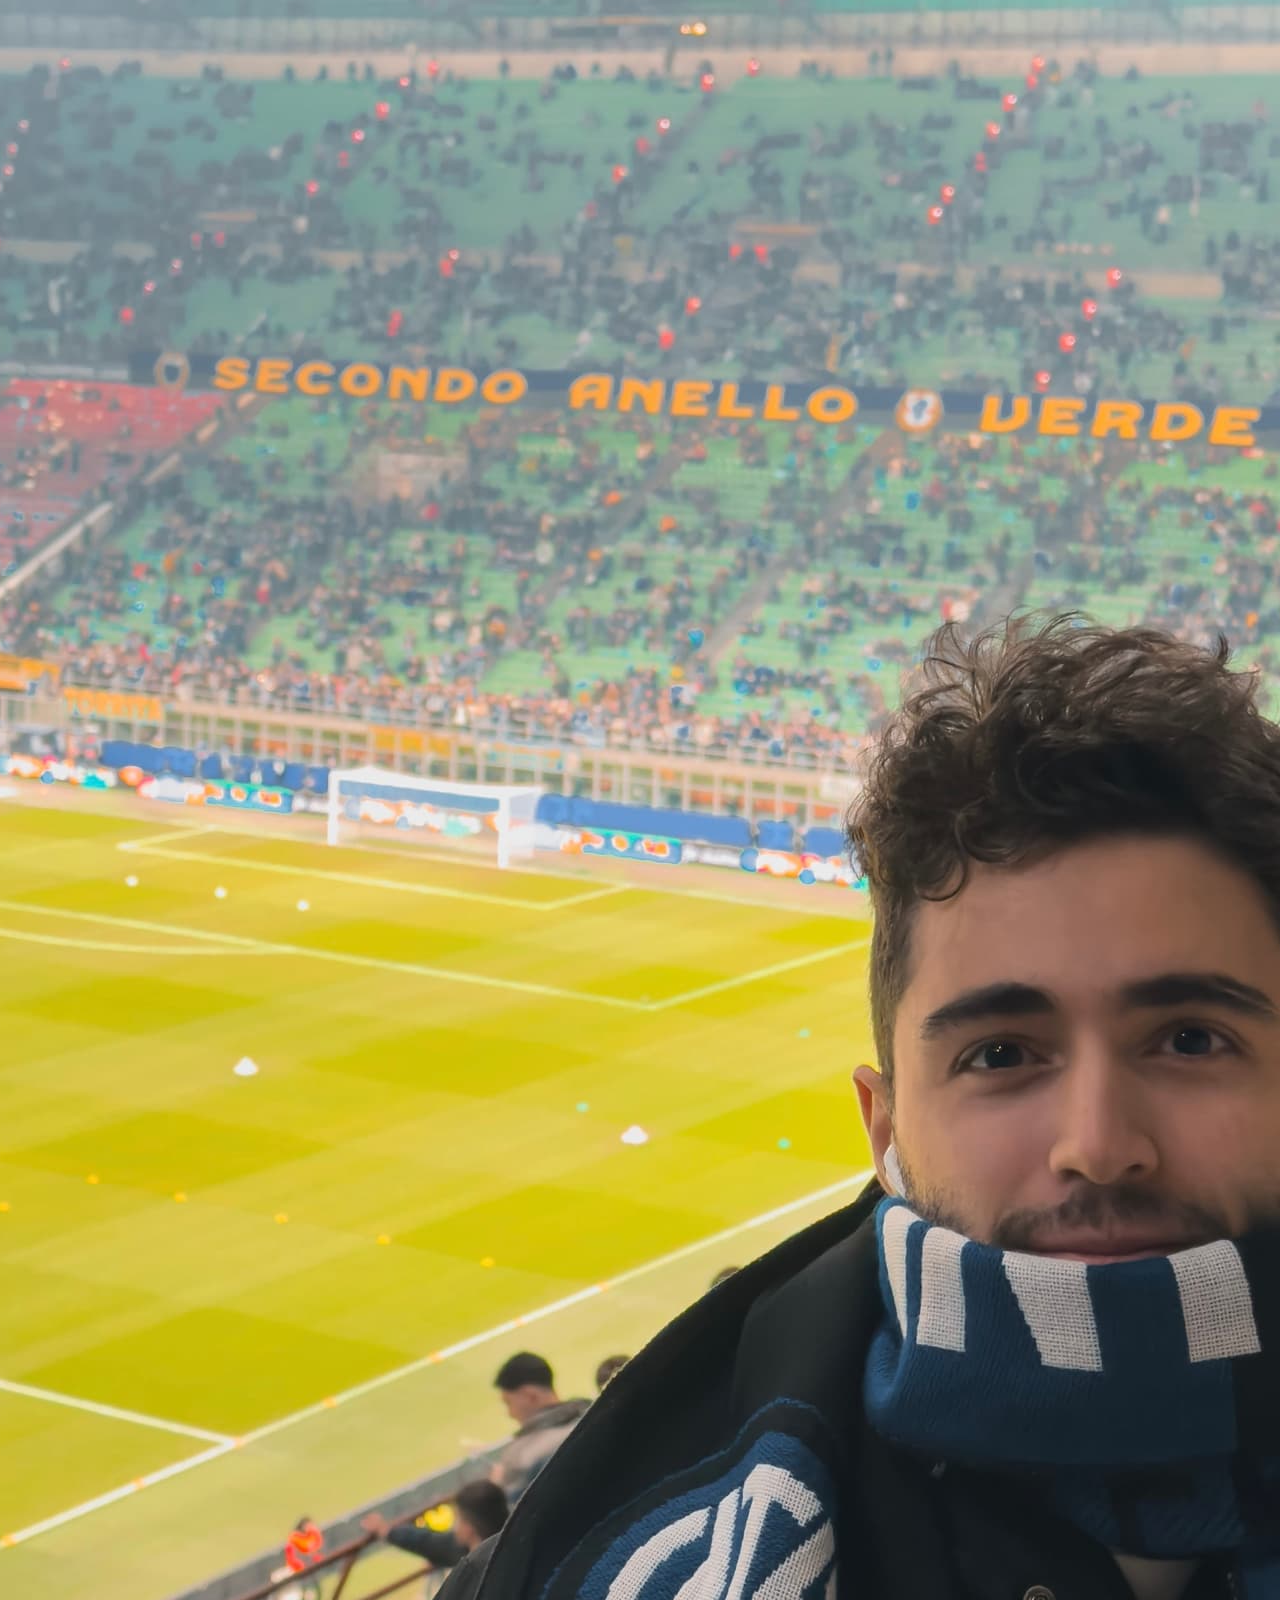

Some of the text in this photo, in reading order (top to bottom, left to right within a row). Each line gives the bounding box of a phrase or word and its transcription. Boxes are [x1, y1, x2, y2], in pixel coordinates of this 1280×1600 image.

[214, 358, 527, 405] SECONDO
[568, 374, 857, 424] ANELLO
[978, 395, 1261, 449] VERDE
